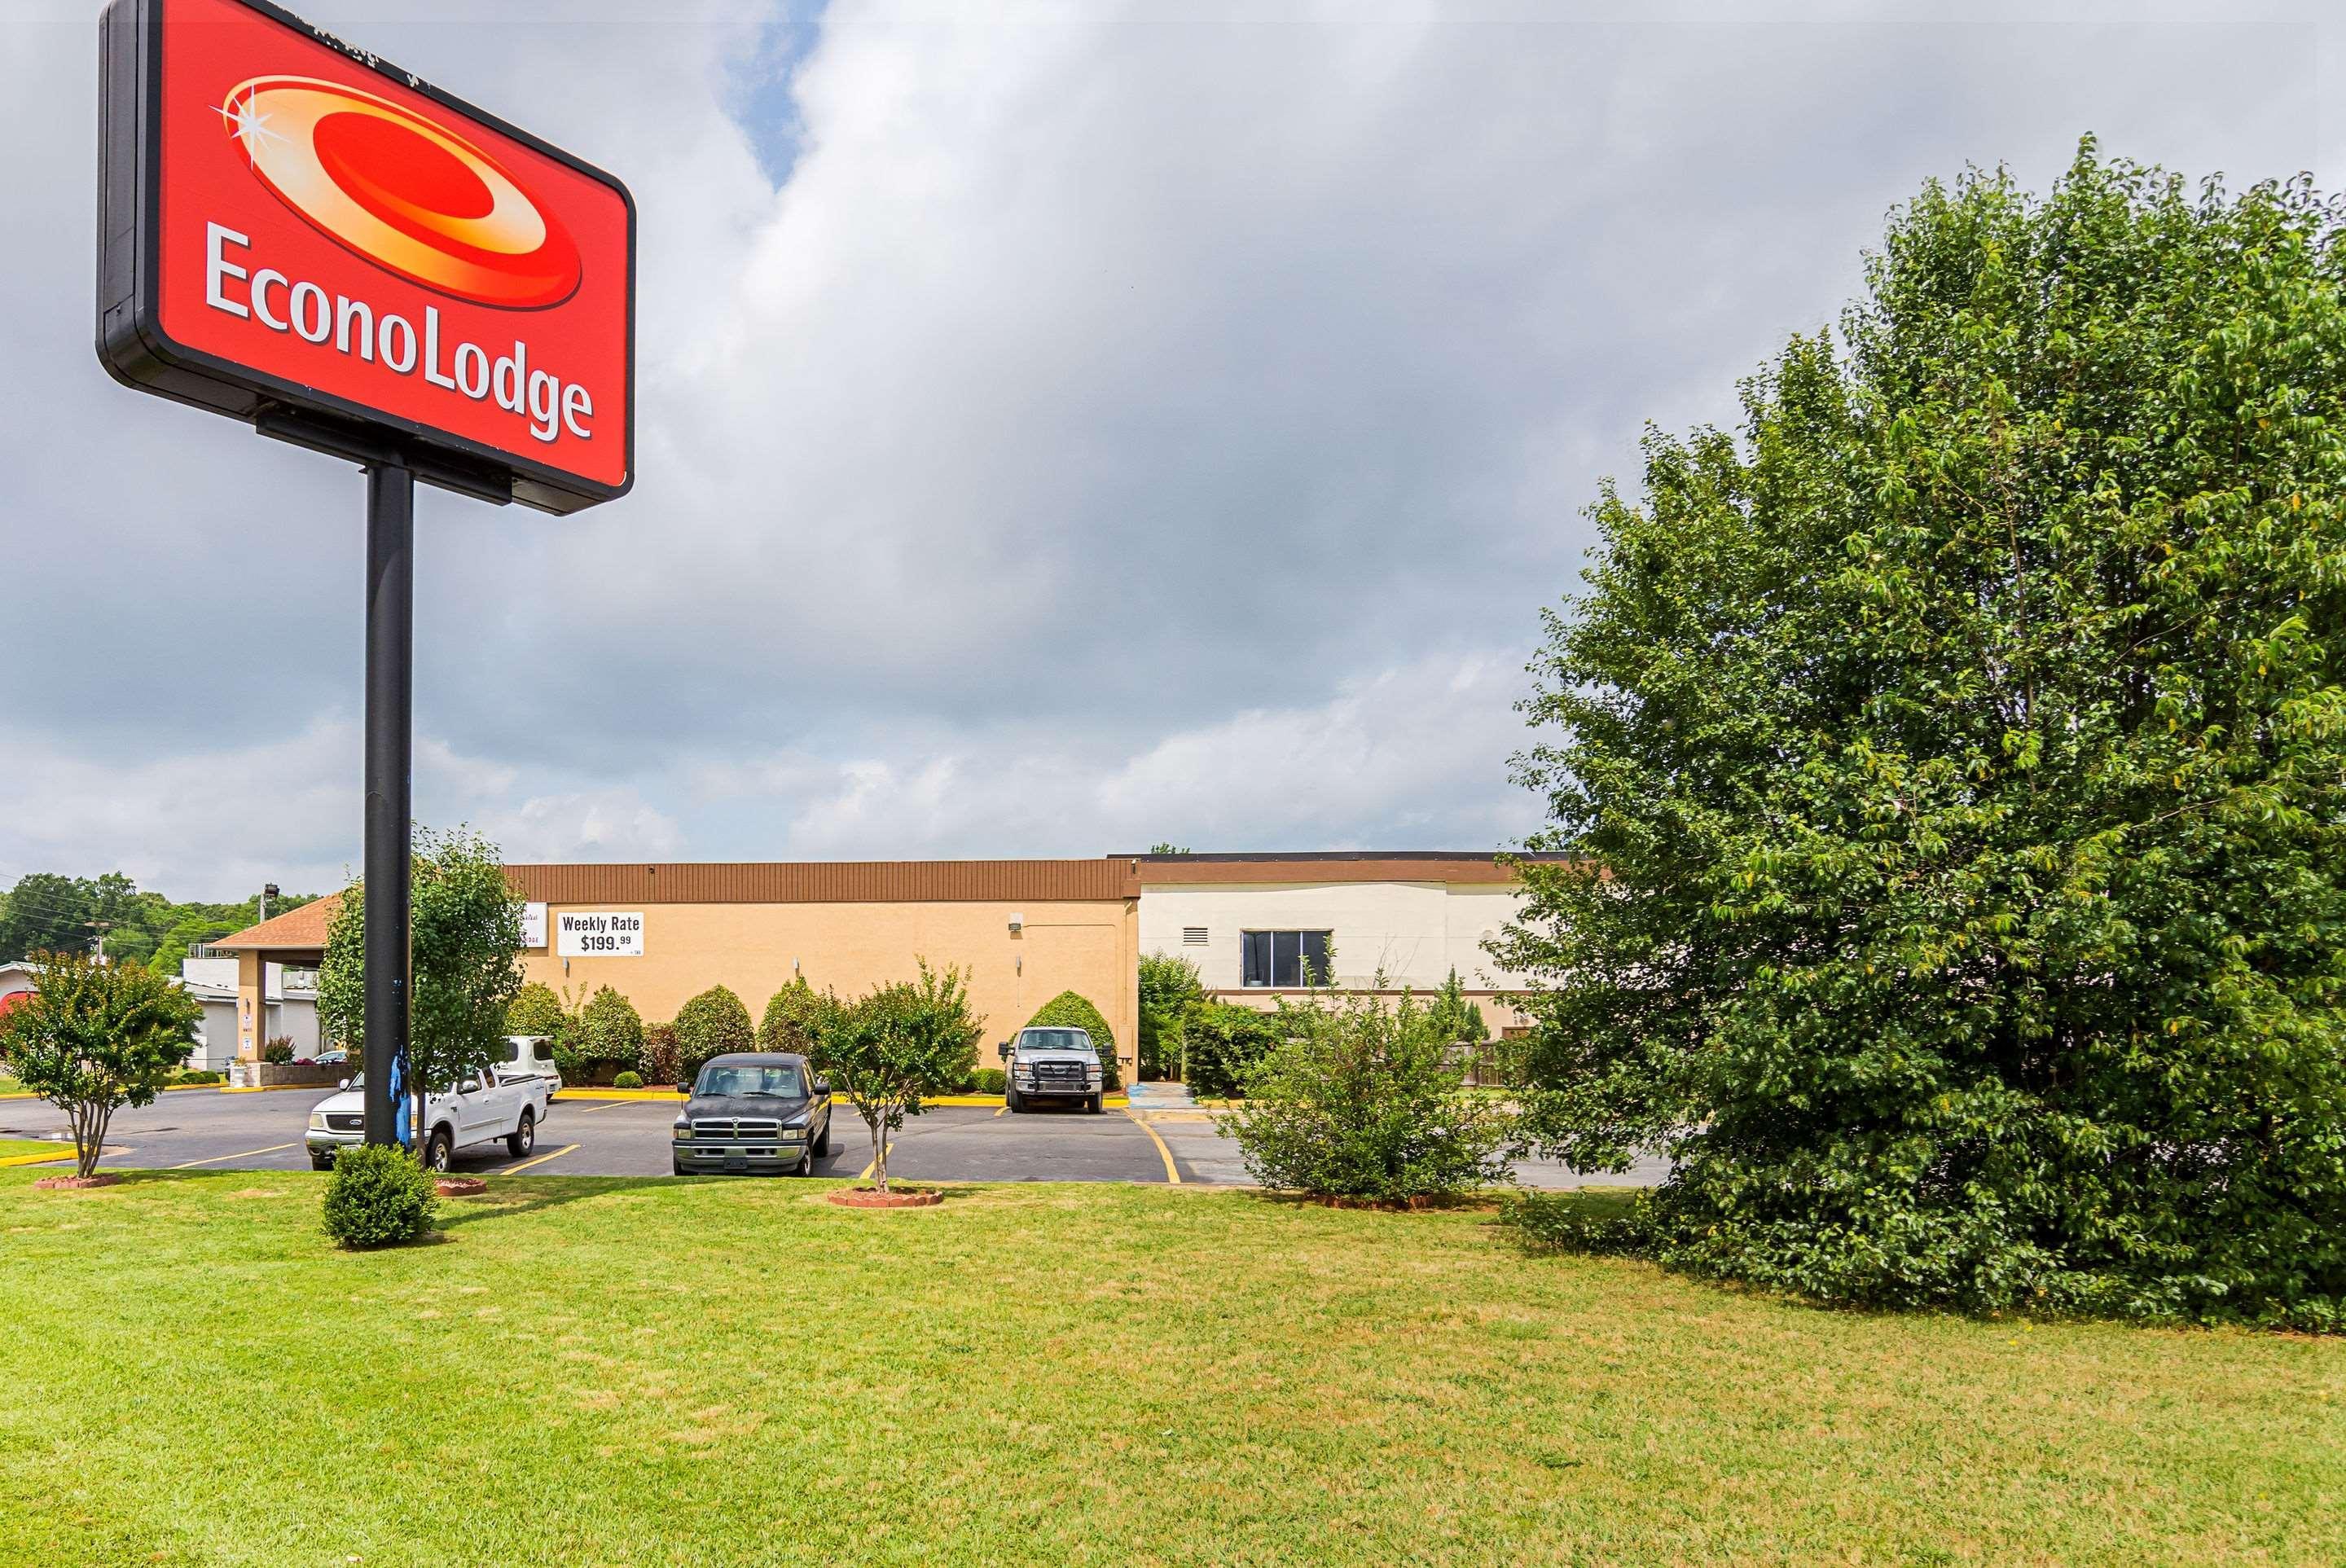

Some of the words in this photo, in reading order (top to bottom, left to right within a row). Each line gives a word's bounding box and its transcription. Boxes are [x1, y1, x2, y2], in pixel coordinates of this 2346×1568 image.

[205, 221, 594, 442] EconoLodge
[563, 916, 607, 933] Weekly
[612, 916, 639, 930] Rate
